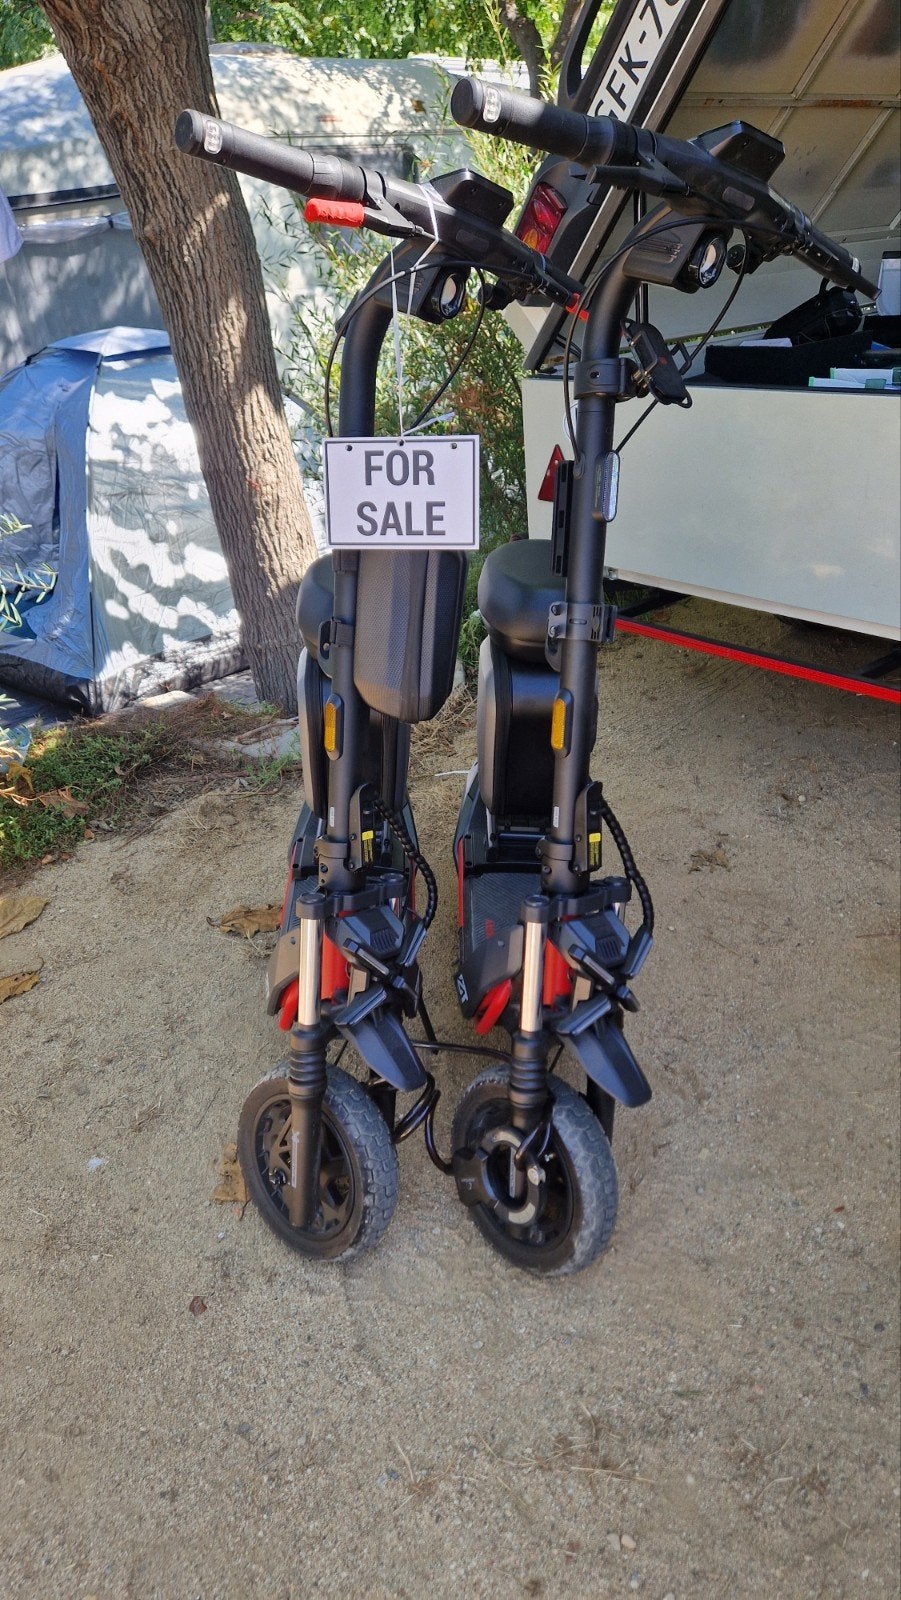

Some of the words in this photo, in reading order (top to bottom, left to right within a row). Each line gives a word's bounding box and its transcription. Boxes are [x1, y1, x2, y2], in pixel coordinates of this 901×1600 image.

[594, 0, 677, 119] GFK-7
[364, 449, 435, 486] FOR
[356, 500, 446, 536] SALE
